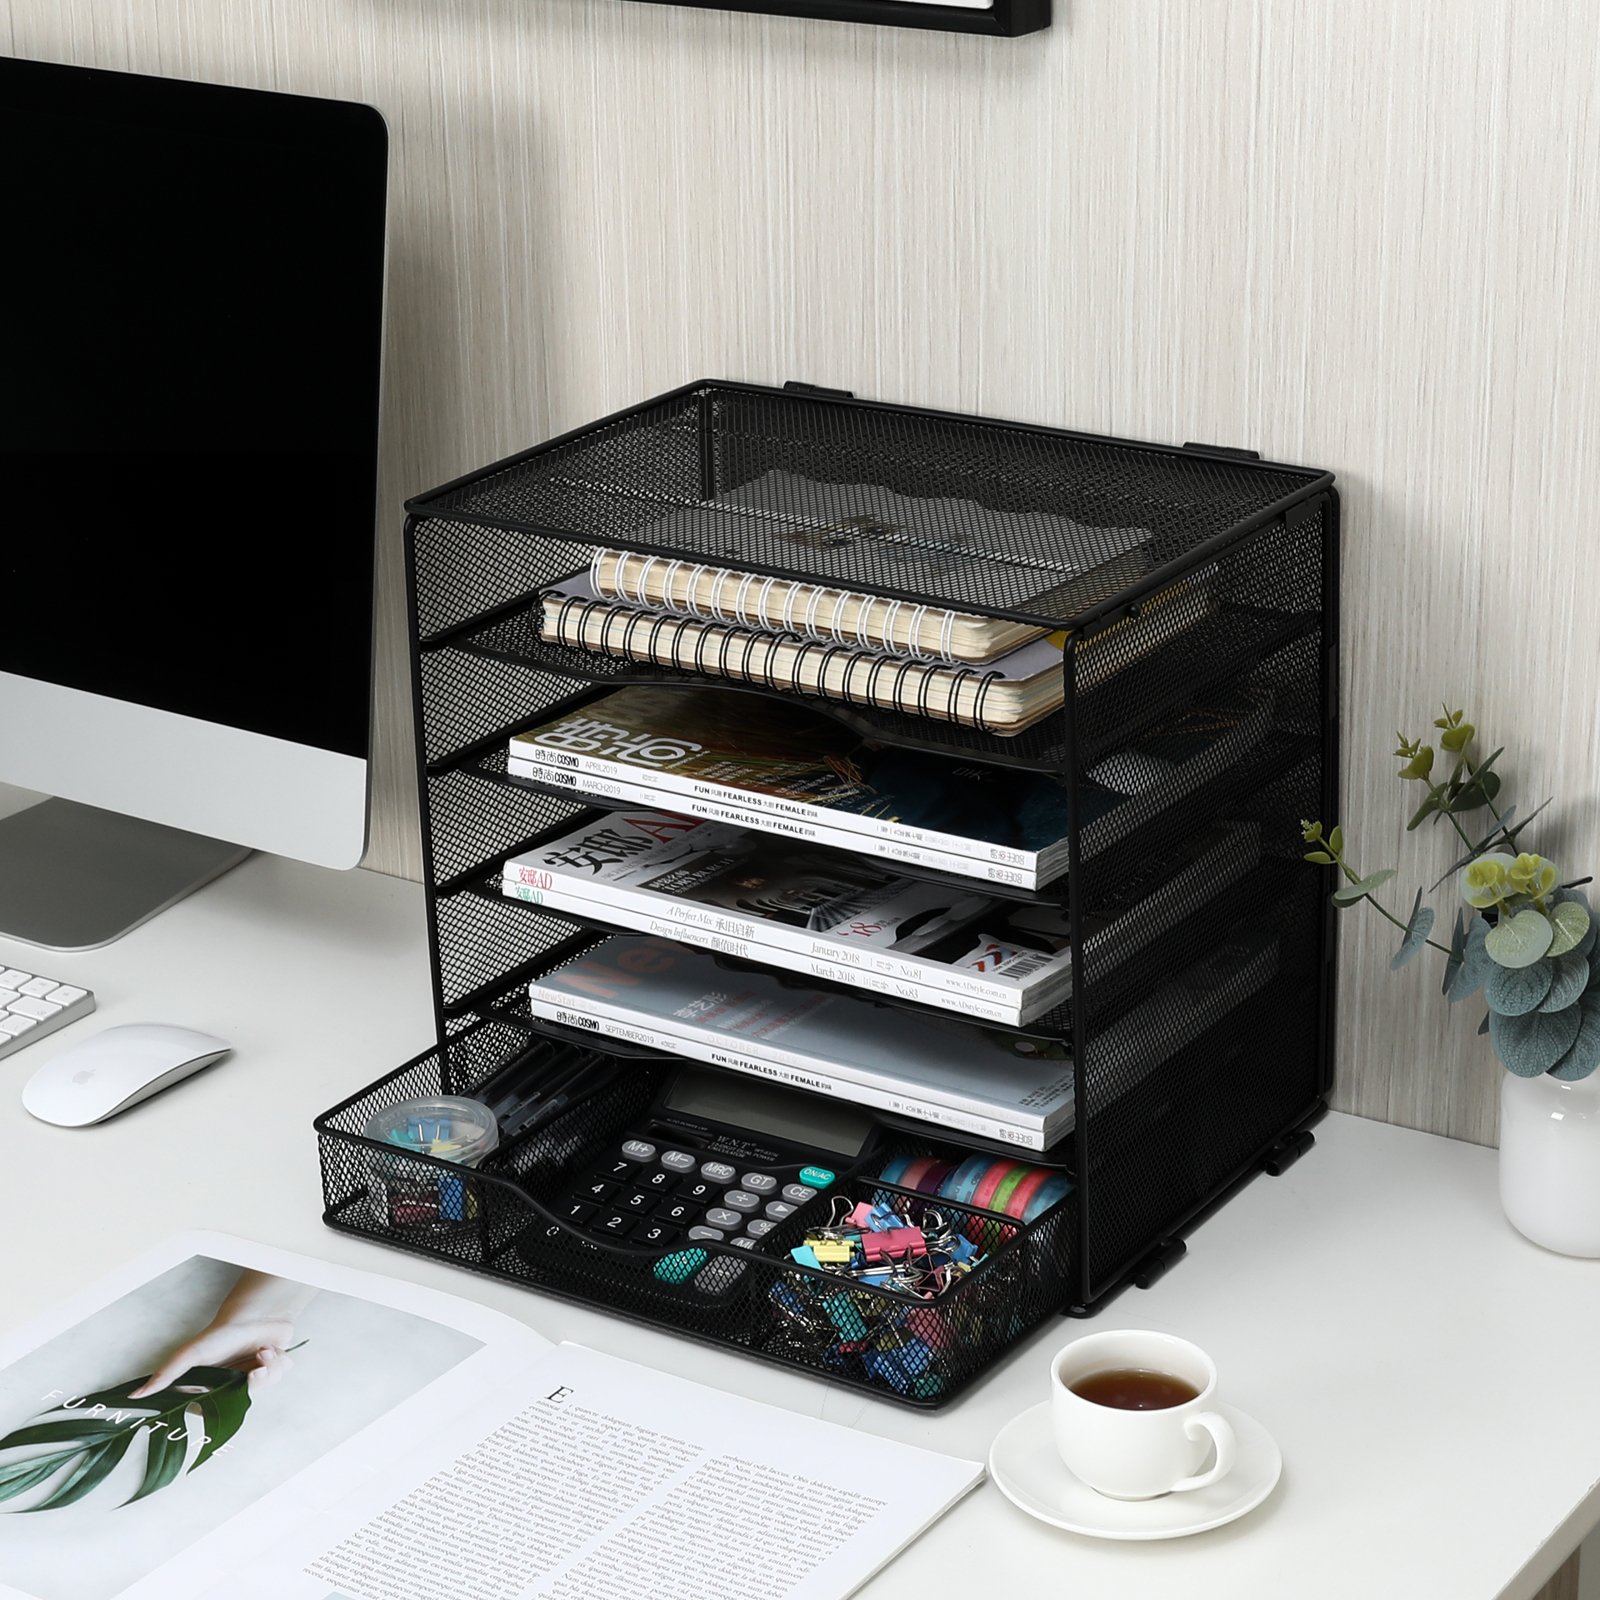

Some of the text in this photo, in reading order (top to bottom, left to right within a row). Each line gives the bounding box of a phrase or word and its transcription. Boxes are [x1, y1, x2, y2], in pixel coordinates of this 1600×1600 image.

[694, 785, 710, 795] FUN
[723, 791, 762, 806] FEARLESS
[775, 803, 806, 816] FEMALE
[691, 804, 708, 814] FUN
[721, 810, 760, 825] FEARLESS
[773, 822, 804, 835] FEMALE
[676, 907, 697, 922] Perfect
[650, 920, 673, 937] Design
[673, 925, 709, 944] Influencers
[811, 942, 842, 962] January
[842, 951, 860, 964] 2018
[810, 962, 838, 980] March
[838, 968, 856, 982] 2018
[711, 1053, 727, 1063] FUN
[739, 1060, 778, 1077] FEARLESS
[790, 1074, 820, 1088] FEMALE
[613, 1162, 627, 1172] 7
[705, 1162, 733, 1176] MRC
[651, 1173, 666, 1184] 8
[750, 1175, 772, 1186] GT
[803, 1168, 832, 1181] ON/AC
[591, 1184, 604, 1193] 4
[692, 1185, 706, 1195] 9
[790, 1186, 812, 1198] CE
[630, 1194, 645, 1205] 5
[570, 1205, 581, 1215] 1
[671, 1206, 685, 1217] 6
[607, 1216, 622, 1228] 2
[647, 1228, 661, 1239] 3
[41, 1388, 235, 1458] FURNITURE
